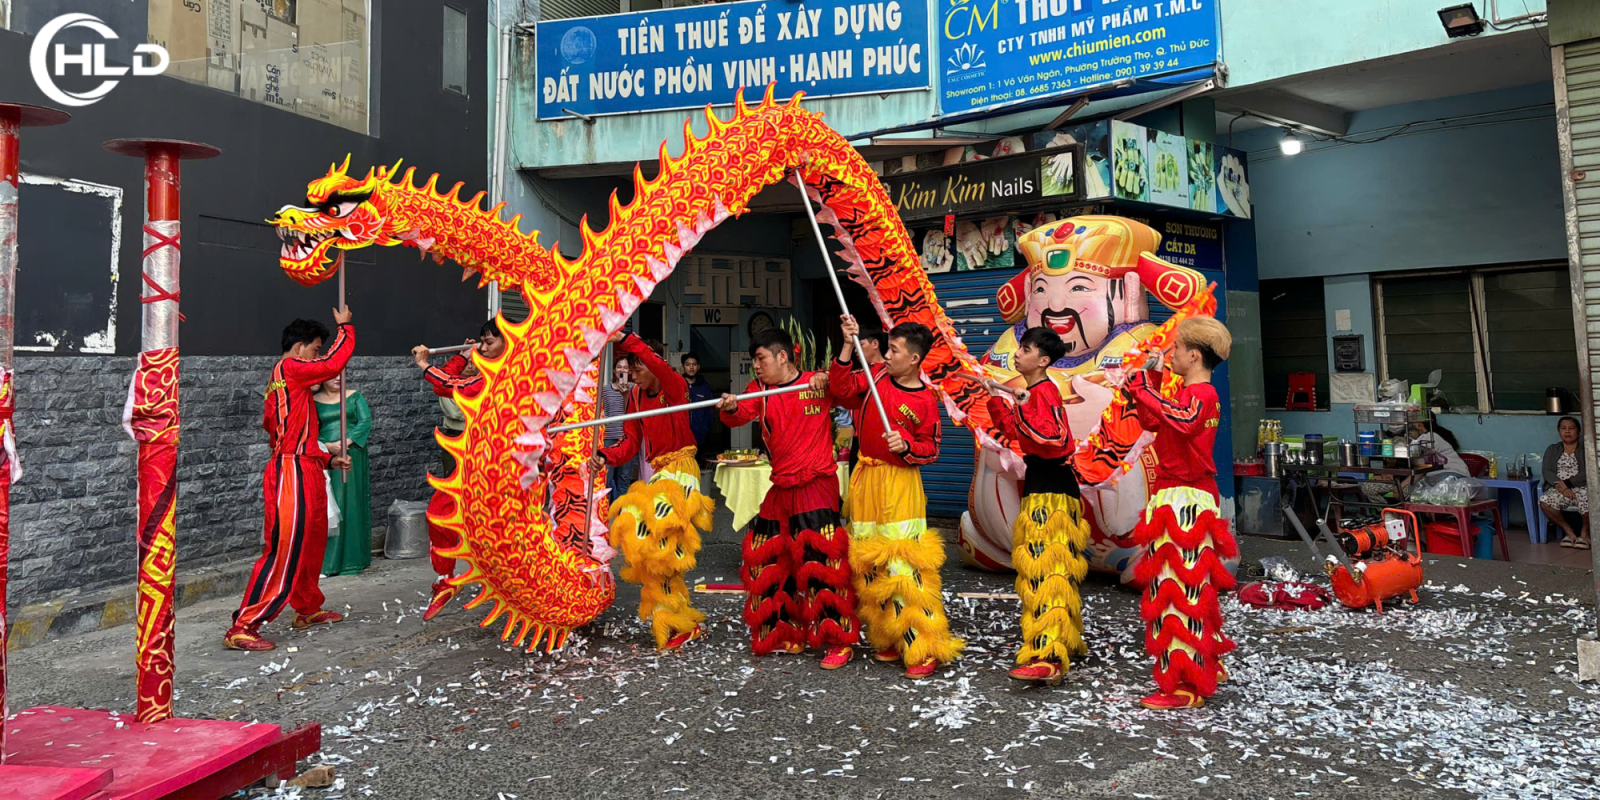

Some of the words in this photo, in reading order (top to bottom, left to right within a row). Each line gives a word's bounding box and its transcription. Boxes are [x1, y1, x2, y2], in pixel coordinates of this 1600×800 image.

[618, 17, 664, 55] TIỀN
[675, 9, 729, 49] THUẾ
[738, 3, 767, 45] ĐỂ
[777, 3, 822, 40] XÂY
[835, 1, 902, 41] DỰNG
[998, 35, 1024, 54] CTY
[1030, 26, 1066, 47] TNHH
[1072, 16, 1095, 37] MỸ
[1102, 4, 1148, 30] PHẨM
[1029, 25, 1166, 66] www.chiumien.com
[543, 67, 580, 104] ĐẤT
[589, 63, 645, 101] NƯỚC
[654, 56, 714, 95] PHỒN
[723, 53, 774, 90] VINH
[790, 50, 853, 86] HẠNH
[863, 38, 921, 76] PHÚC
[946, 84, 986, 98] Showroom
[1003, 77, 1016, 87] Võ
[1017, 73, 1035, 84] Văn
[1065, 60, 1099, 75] Phường
[1101, 53, 1132, 68] Trường
[1156, 46, 1167, 56] Q.
[1170, 41, 1187, 53] Thủ
[1189, 38, 1210, 49] Đức
[1015, 86, 1027, 97] 08.
[1029, 82, 1049, 95] 6685
[1051, 78, 1072, 91] 7363
[1079, 71, 1113, 86] Hotline:
[1115, 65, 1136, 78] 0901
[1140, 63, 1152, 74] 39
[1153, 60, 1165, 71] 39
[1167, 57, 1179, 68] 44
[897, 181, 936, 211] Kim
[942, 174, 986, 206] Kim
[991, 177, 1034, 199] Nails
[1184, 243, 1197, 255] DA
[704, 308, 722, 323] WC
